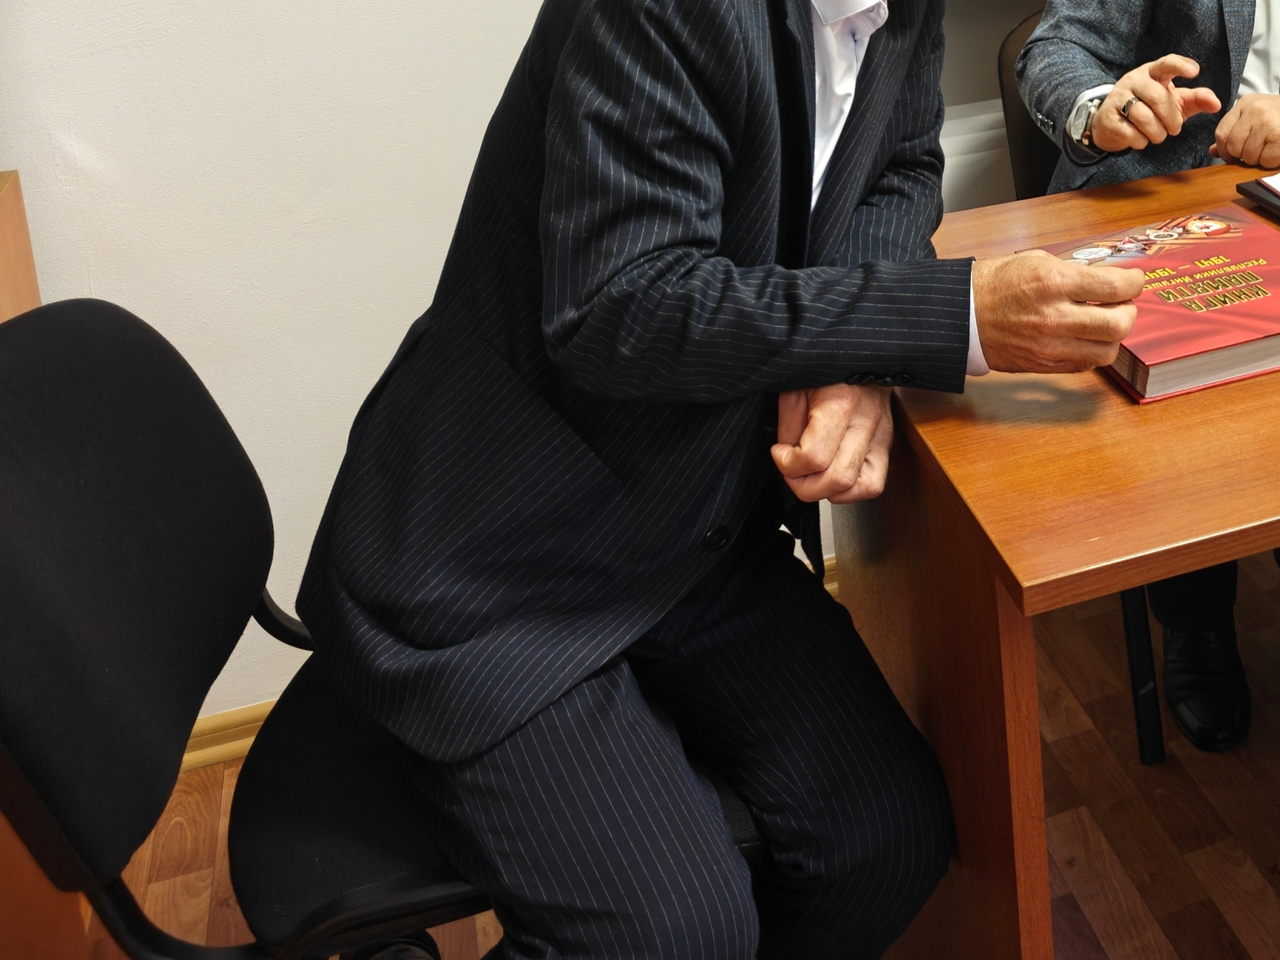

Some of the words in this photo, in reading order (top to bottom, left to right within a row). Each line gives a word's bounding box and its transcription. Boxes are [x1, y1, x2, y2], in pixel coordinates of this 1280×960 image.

[1194, 255, 1231, 269] 1941
[1156, 270, 1263, 303] ПАМЯТИ
[1182, 284, 1272, 313] КНИГА
